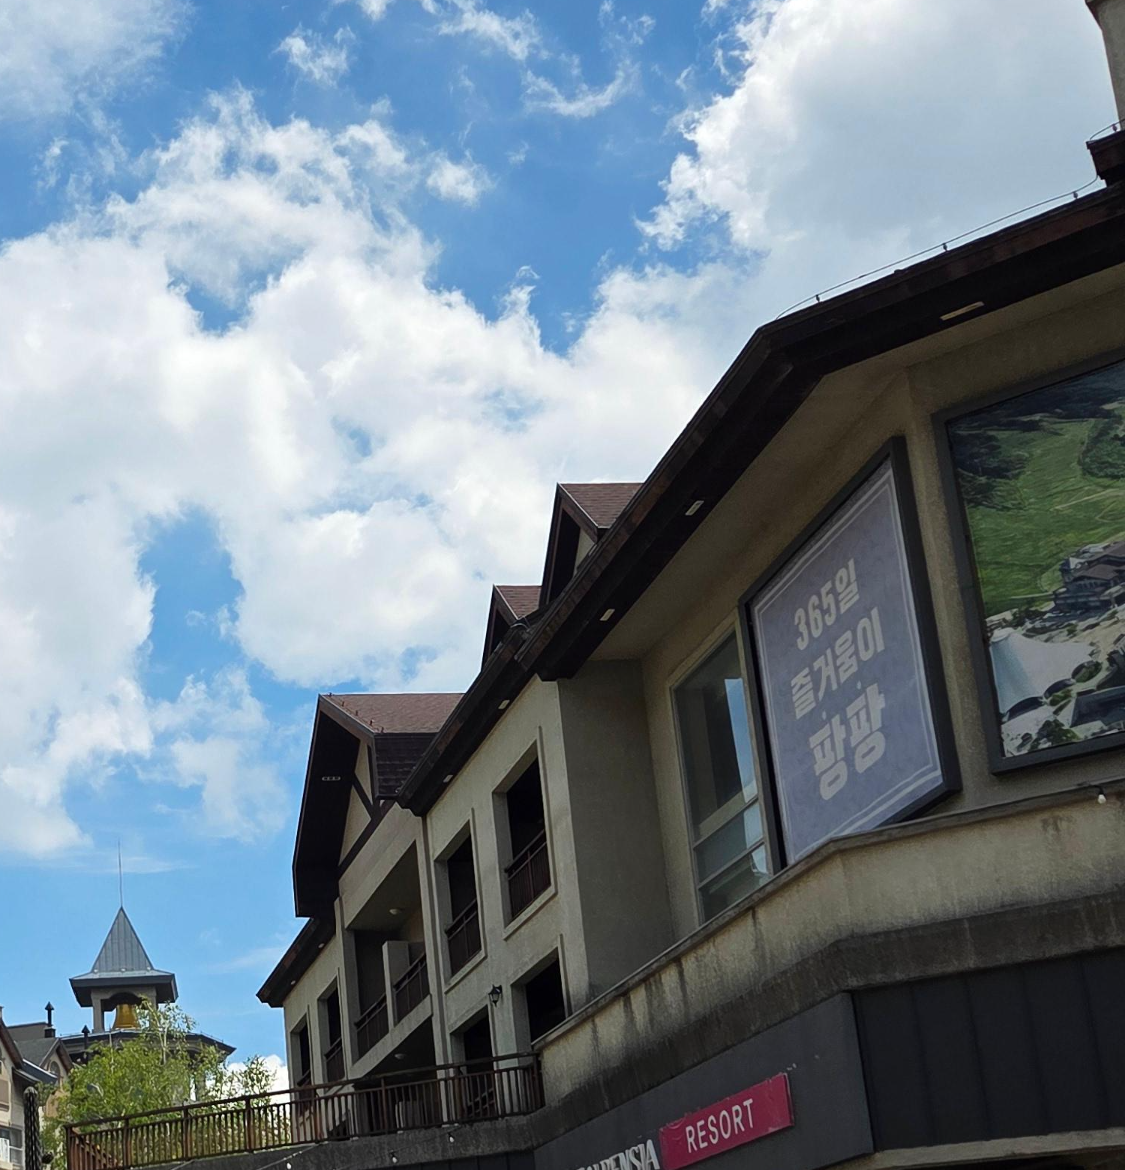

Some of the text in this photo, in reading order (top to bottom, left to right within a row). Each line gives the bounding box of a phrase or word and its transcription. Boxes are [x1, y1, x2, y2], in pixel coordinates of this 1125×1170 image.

[794, 558, 860, 651] 365일
[791, 606, 886, 720] 즐거움이
[809, 682, 886, 801] 팡팡
[685, 1099, 755, 1154] RESORT
